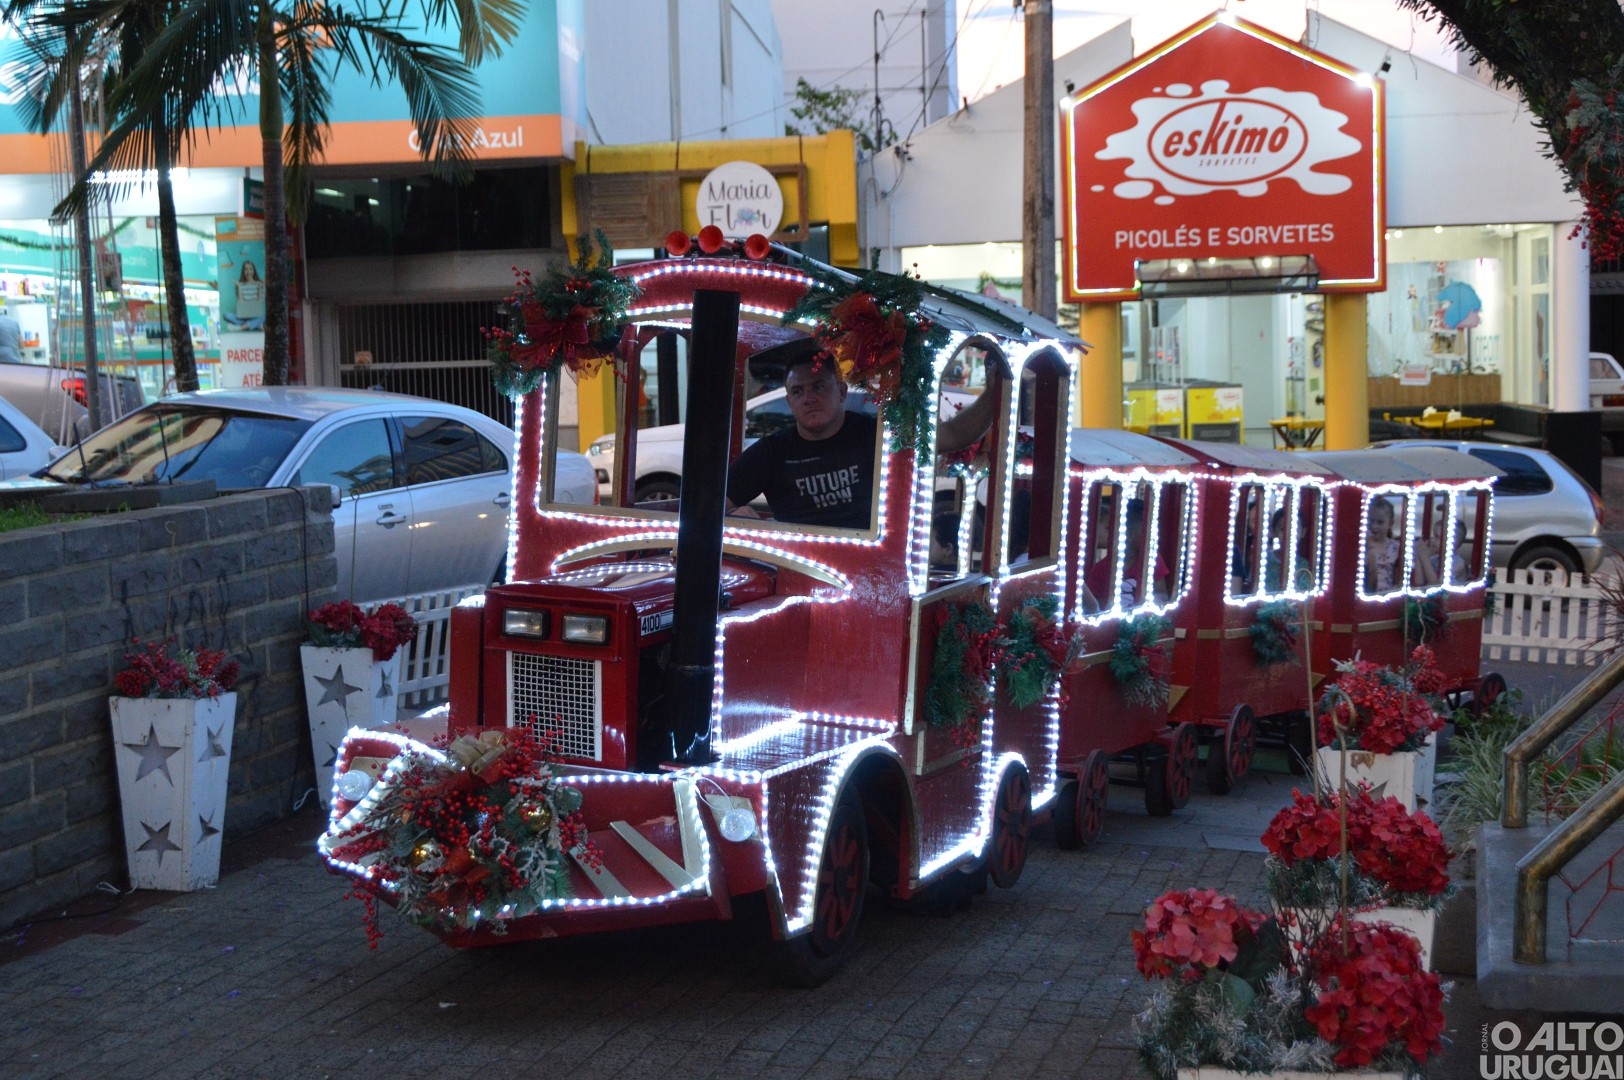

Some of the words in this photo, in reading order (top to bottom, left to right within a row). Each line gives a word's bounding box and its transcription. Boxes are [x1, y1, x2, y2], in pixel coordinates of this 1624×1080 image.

[470, 125, 523, 149] Azul
[1163, 101, 1291, 157] eskimó
[1199, 157, 1257, 167] SORVETES
[707, 180, 772, 202] Maria
[1115, 224, 1202, 249] PICOLÉS
[1208, 227, 1221, 246] E
[1227, 223, 1335, 246] SORVETES
[795, 465, 859, 496] FUTURE
[813, 486, 852, 508] NOW
[641, 613, 660, 634] 4100
